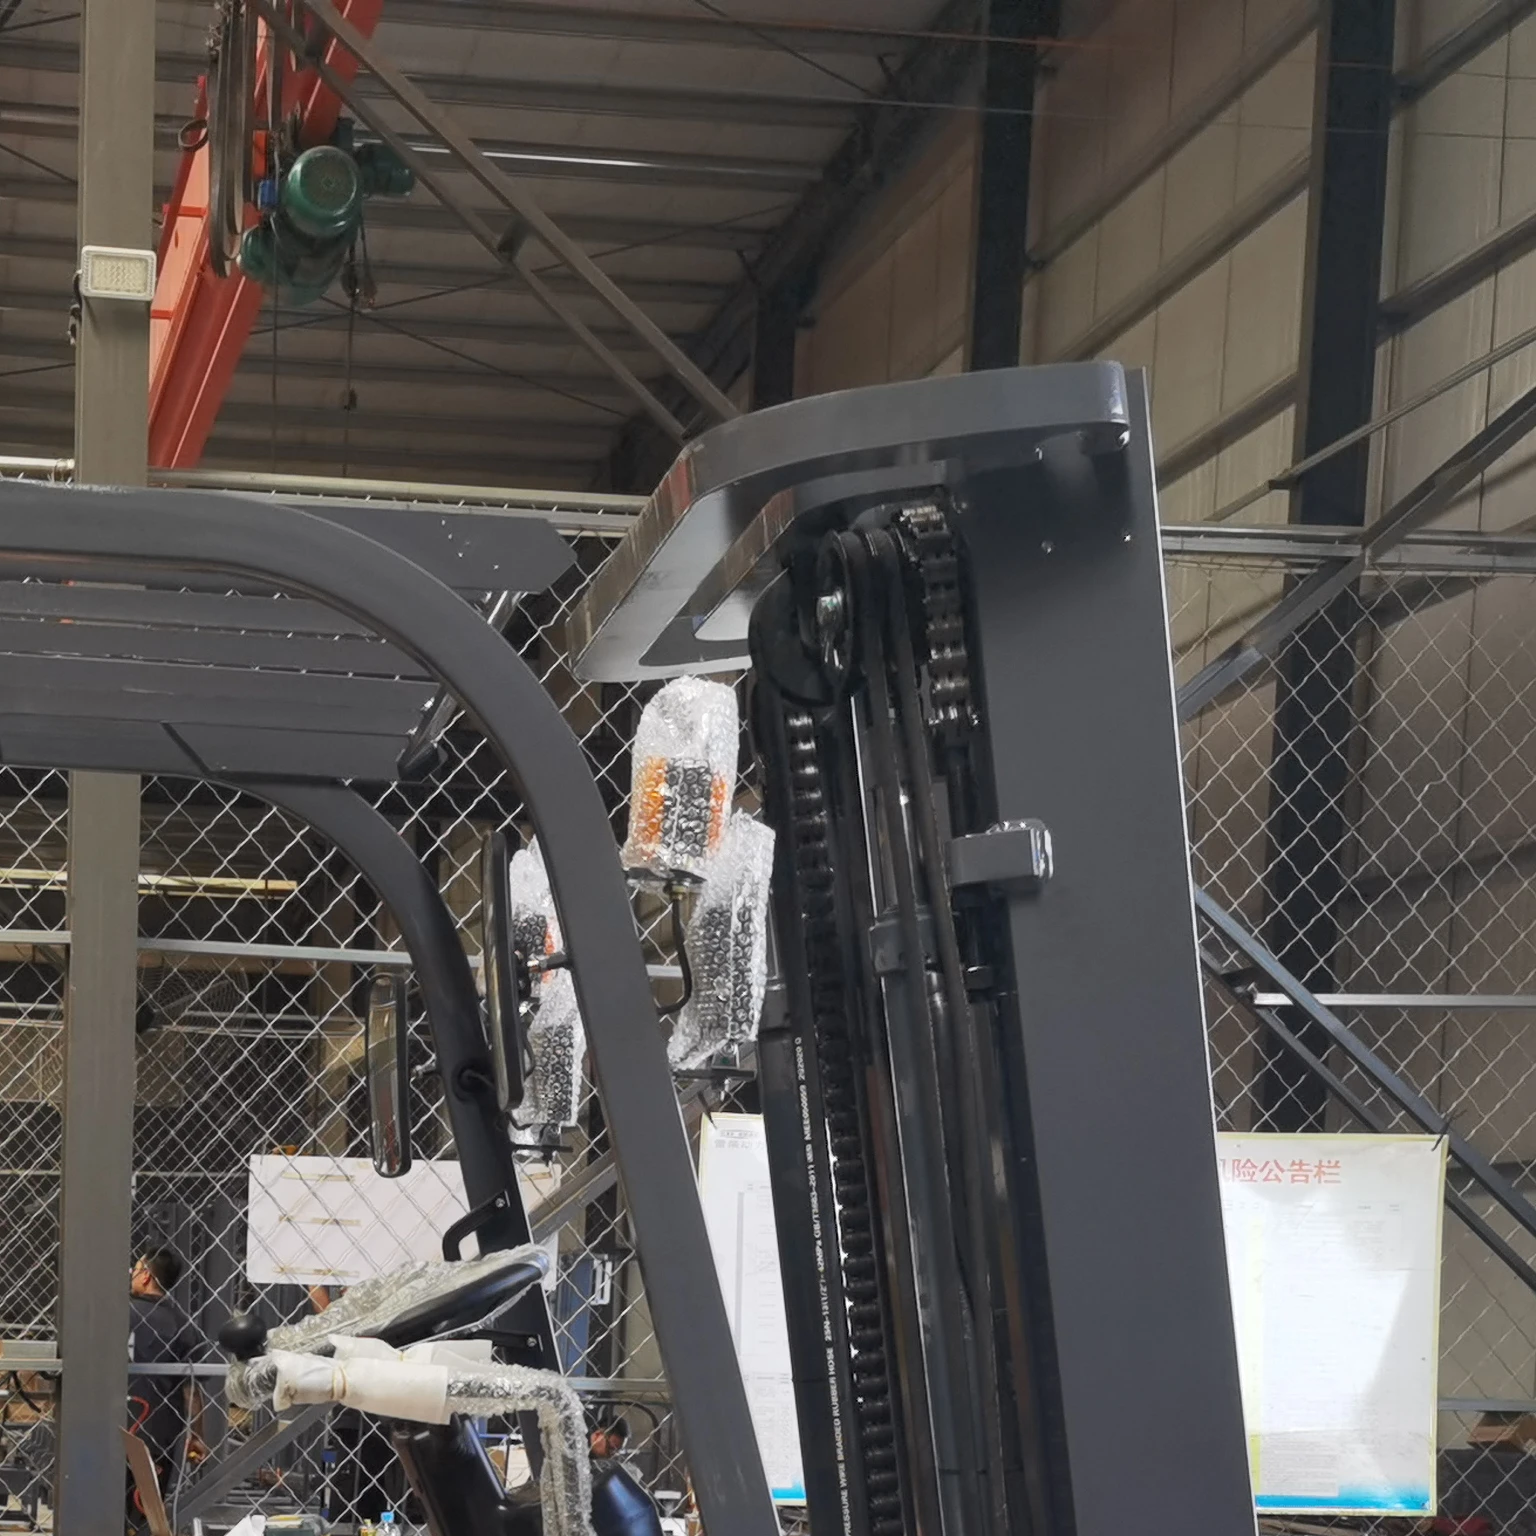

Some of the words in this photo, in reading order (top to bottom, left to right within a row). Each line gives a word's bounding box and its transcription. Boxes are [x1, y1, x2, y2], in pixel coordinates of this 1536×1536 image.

[825, 1347, 835, 1375] HOSE
[828, 1376, 840, 1417] RUBBER
[833, 1418, 845, 1461] BRAIDED
[837, 1462, 848, 1487] WIRE
